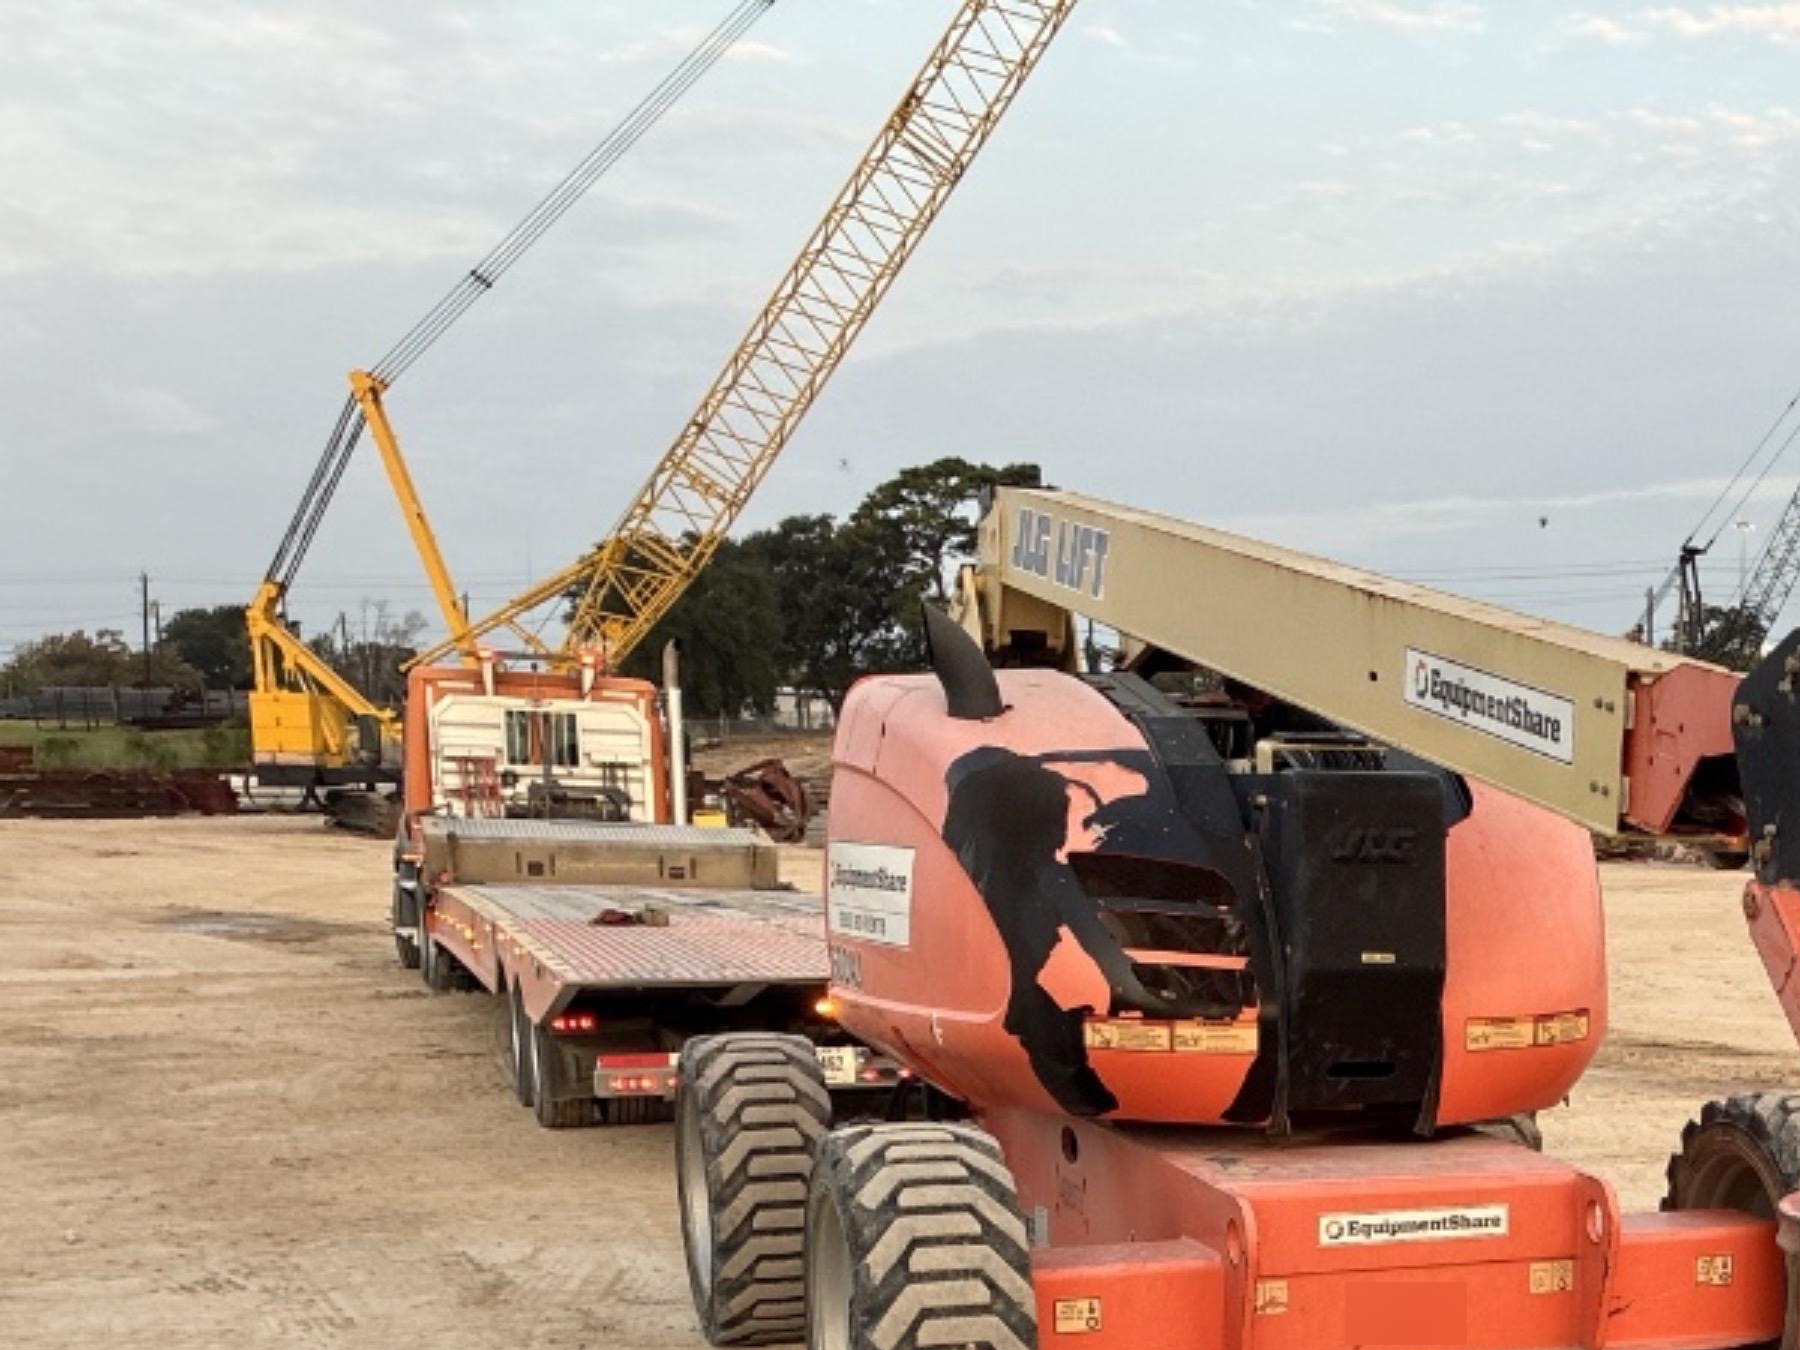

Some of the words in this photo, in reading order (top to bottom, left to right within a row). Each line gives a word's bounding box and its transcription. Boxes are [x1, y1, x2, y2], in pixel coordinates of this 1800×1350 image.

[1013, 508, 1051, 577] JLG
[1055, 520, 1108, 599] LIFT
[1430, 668, 1561, 743] EquipmentShare
[1348, 1214, 1502, 1238] EquipmentShare
